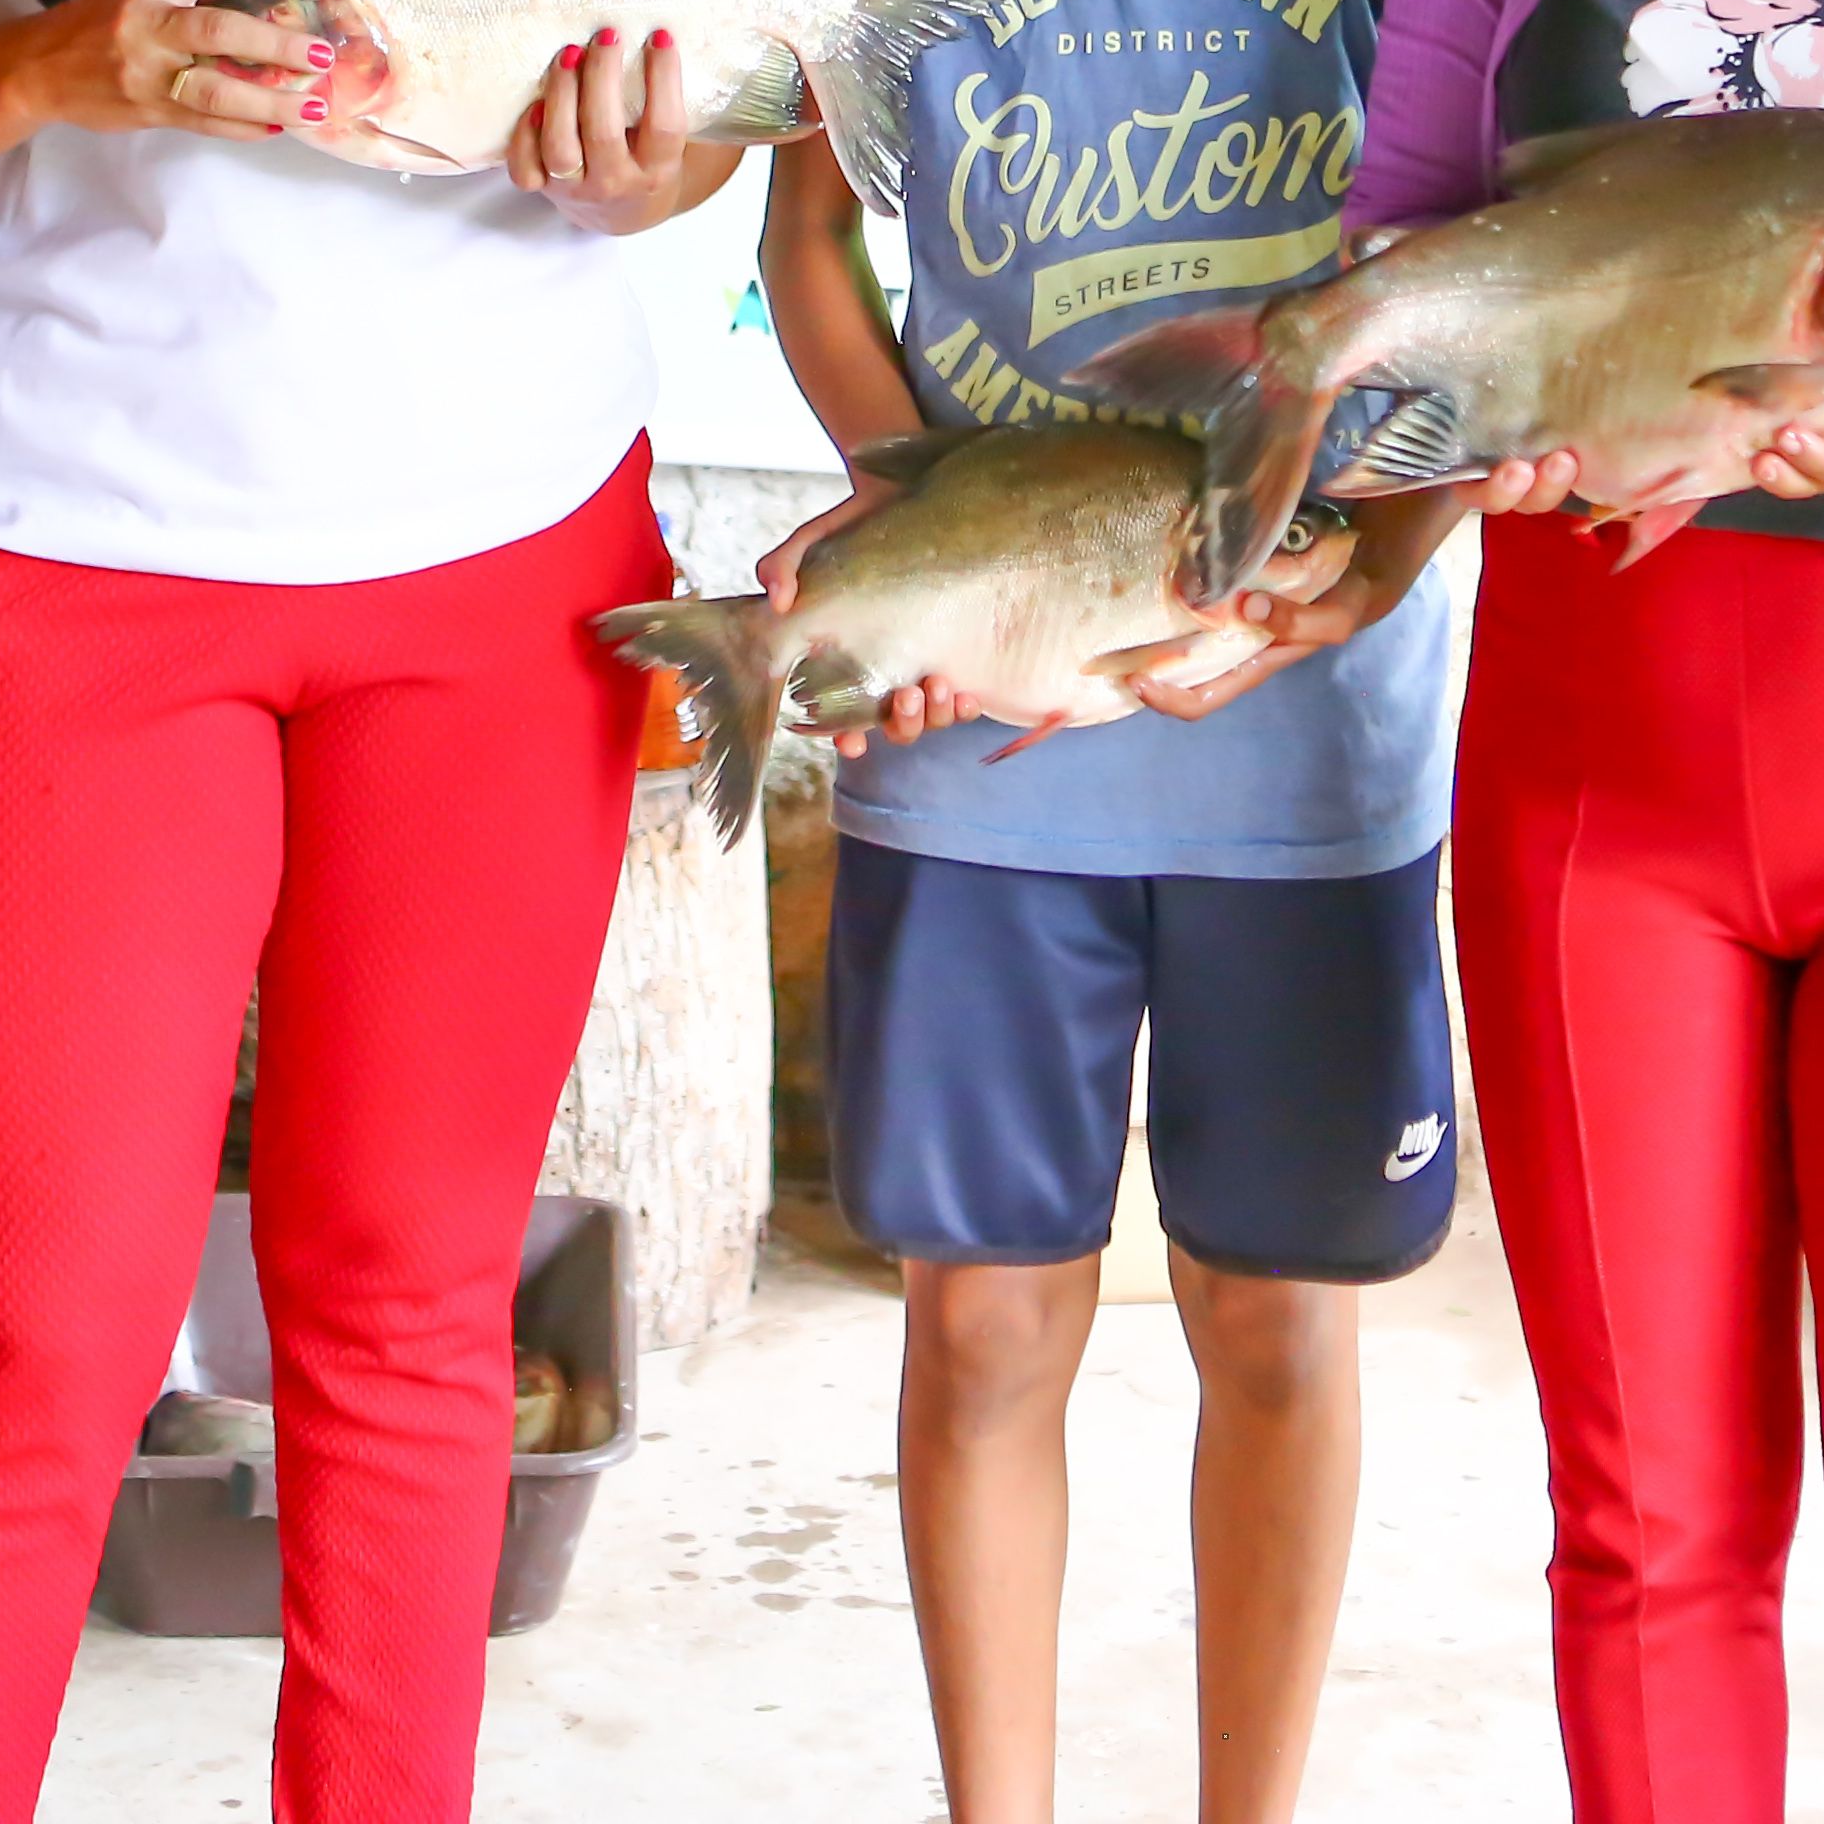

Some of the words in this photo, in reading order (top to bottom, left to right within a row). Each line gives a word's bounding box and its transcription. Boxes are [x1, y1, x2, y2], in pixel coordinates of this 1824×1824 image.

[1057, 28, 1251, 56] DISTRICT
[949, 70, 1359, 278] Custom
[1055, 256, 1212, 316] STREETS
